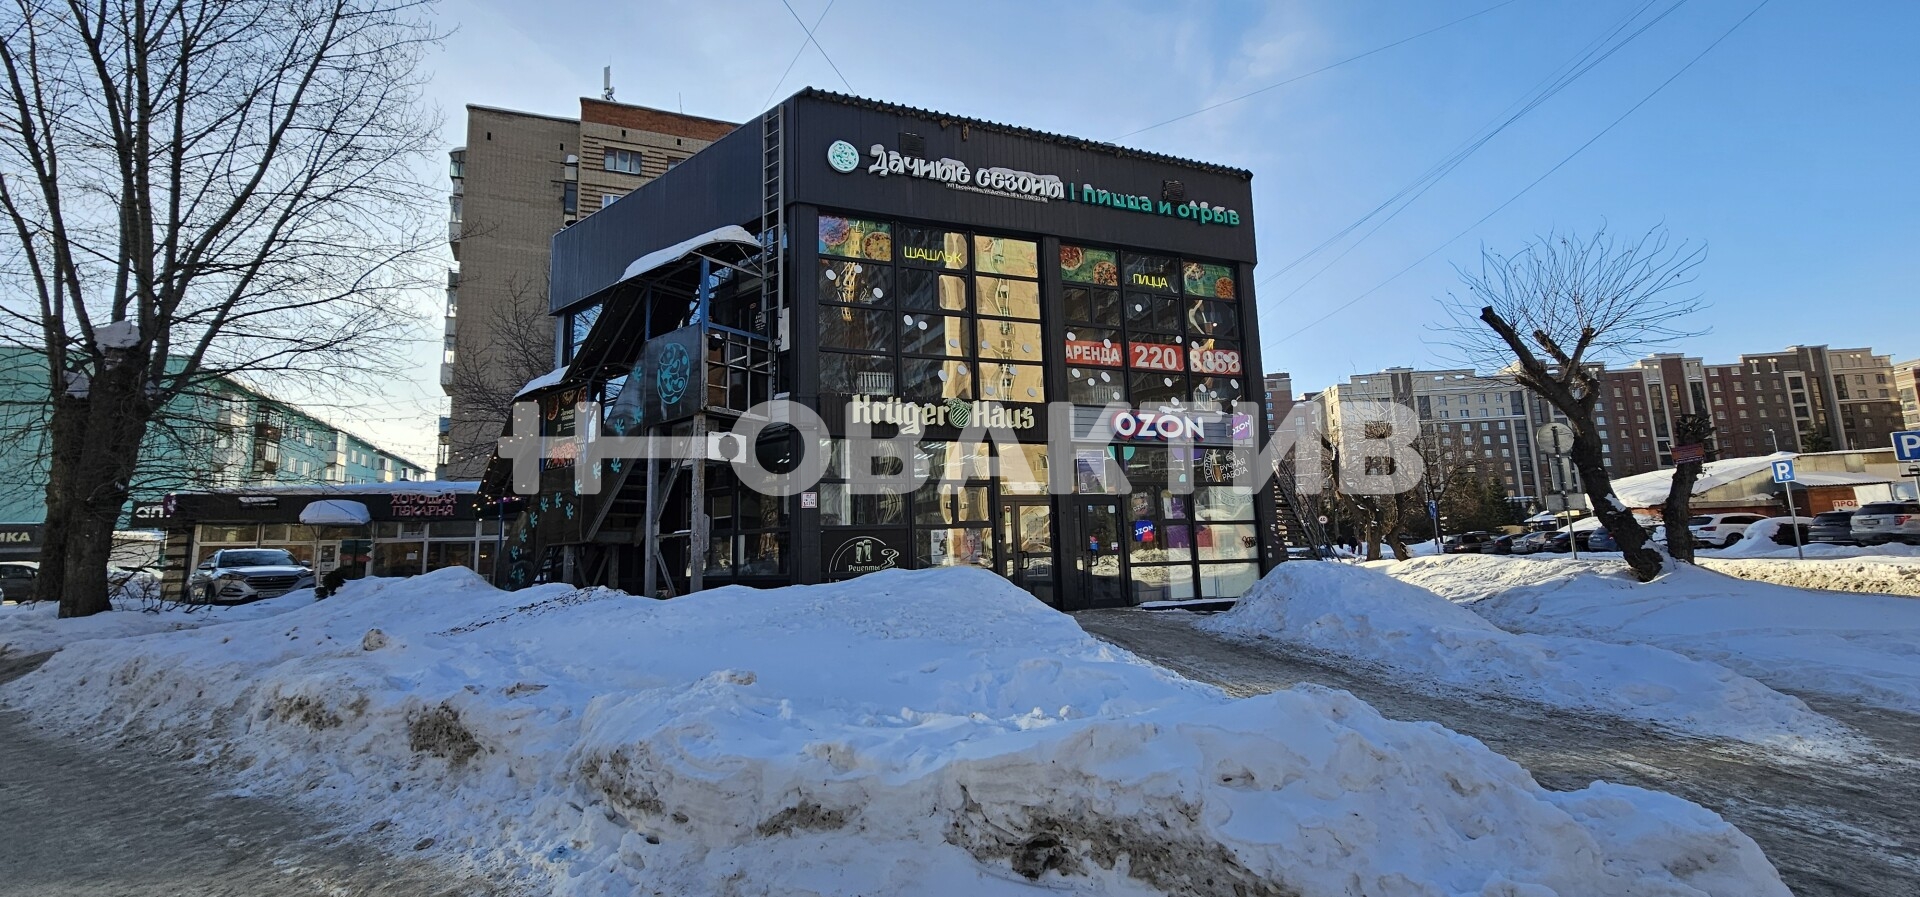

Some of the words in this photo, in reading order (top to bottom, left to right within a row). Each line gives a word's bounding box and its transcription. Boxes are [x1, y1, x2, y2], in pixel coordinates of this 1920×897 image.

[868, 146, 971, 184] Дачные
[975, 167, 1065, 199] сезоны
[1083, 186, 1153, 213] пицца
[1157, 200, 1172, 215] и
[1176, 203, 1241, 227] отрыв
[1132, 273, 1168, 289] ПИЦЦА
[1066, 344, 1121, 364] АРЕНДА
[1134, 345, 1177, 370] 220
[852, 394, 949, 435] Krüger
[972, 399, 1035, 430] Haus
[1112, 411, 1205, 441] OZON
[1219, 457, 1246, 474] РУЧНАЯ
[1222, 466, 1249, 481] РАБОТА
[390, 491, 457, 504] ХОРОШАЯ
[392, 505, 455, 516] ПЕКАРНЯ
